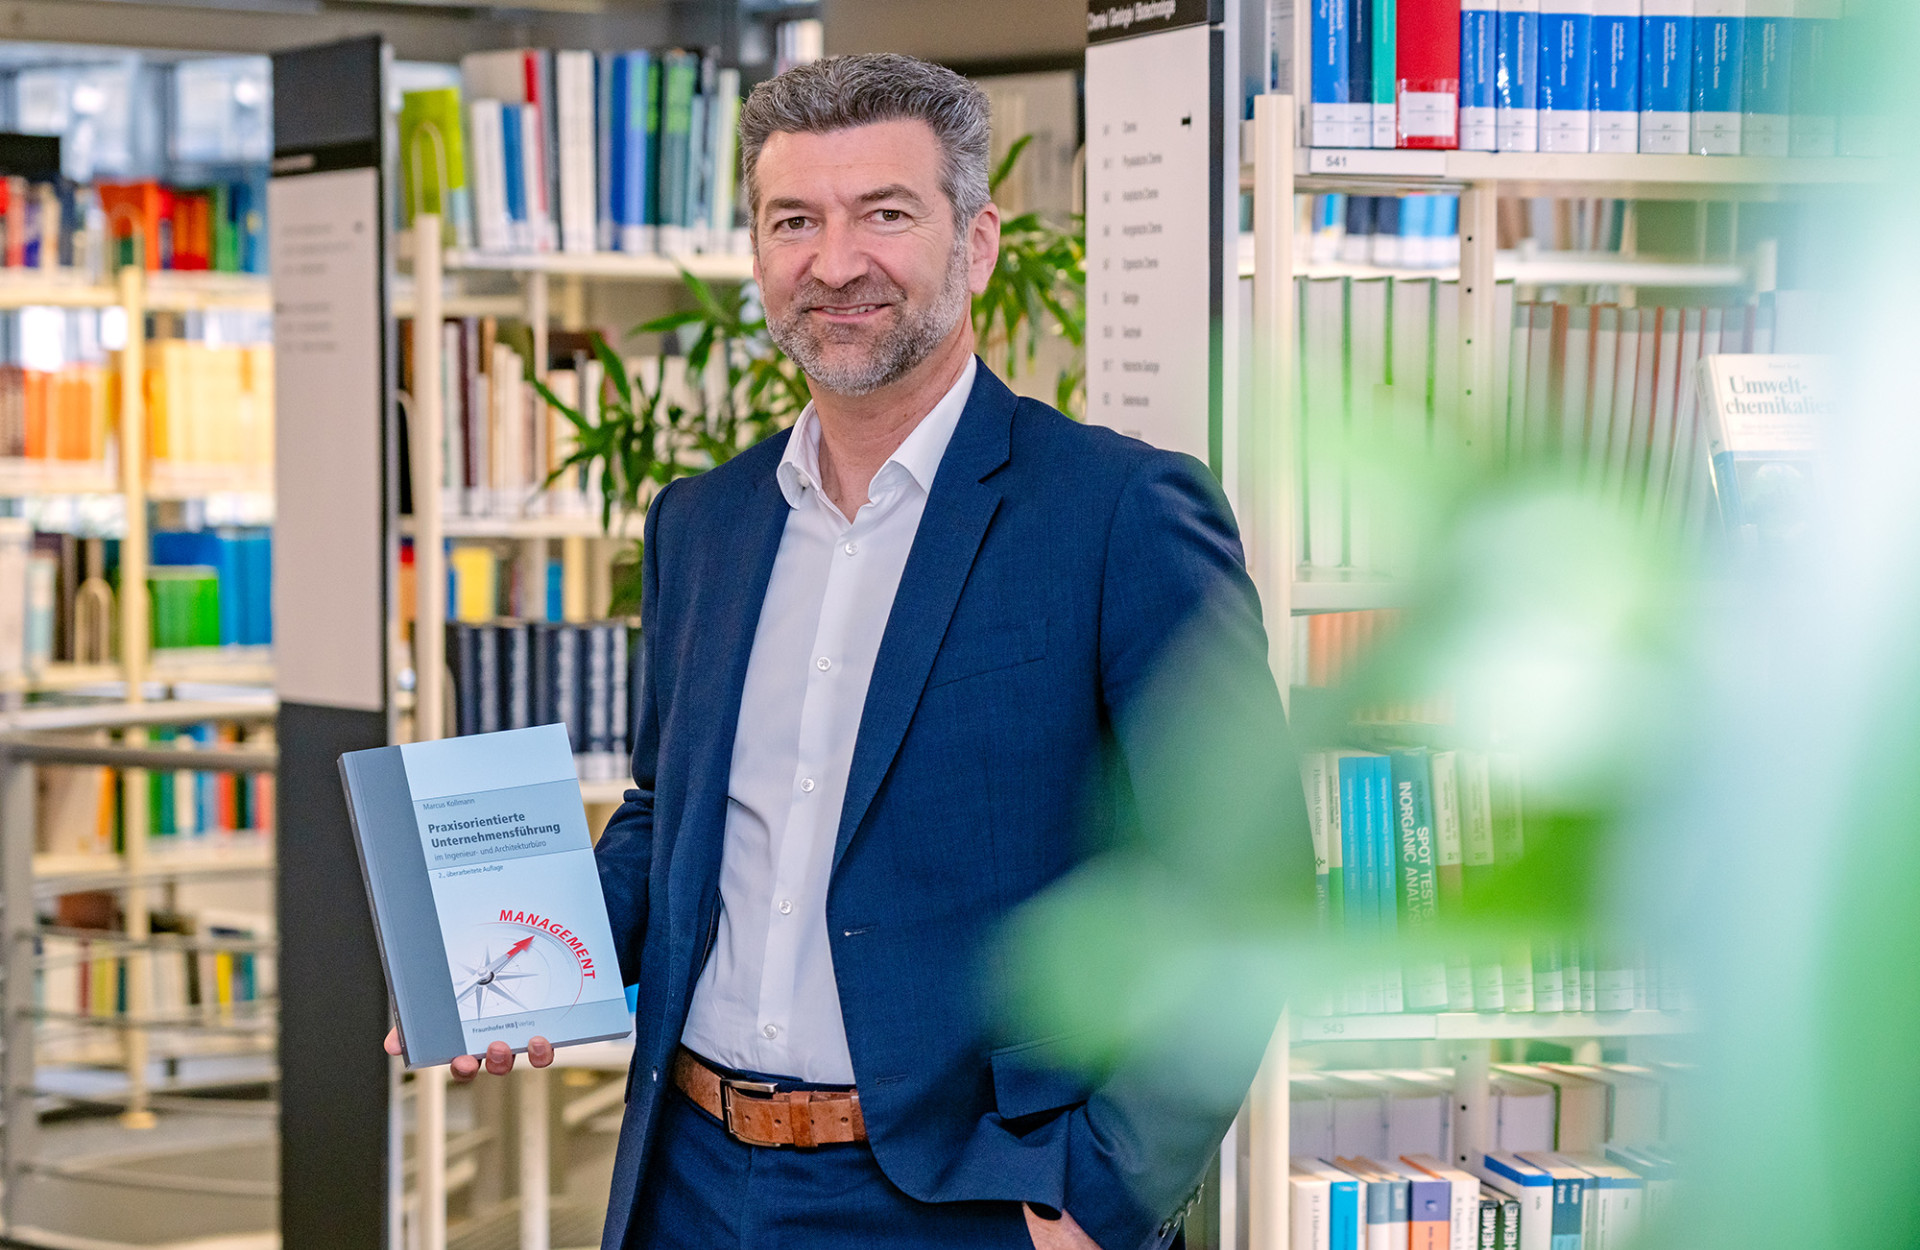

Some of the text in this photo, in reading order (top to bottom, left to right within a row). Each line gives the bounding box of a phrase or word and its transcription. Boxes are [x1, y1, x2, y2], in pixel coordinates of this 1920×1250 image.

[1326, 156, 1347, 167] 541
[1729, 375, 1808, 395] Umwelt-
[422, 798, 476, 810] Marcus Kollmann
[1312, 769, 1322, 836] Helmuth Galster
[428, 812, 526, 834] Praxisorientierte
[1399, 781, 1416, 862] INORGANIC
[431, 823, 561, 848] Unternehmensführung
[1416, 826, 1431, 866] SPOT
[434, 840, 547, 862] im Ingenieur- und Architekturbüro
[446, 866, 482, 877] überarbeitete
[483, 864, 504, 872] Auflage
[1420, 870, 1434, 919] TESTS
[500, 909, 596, 980] MANAGEMENT
[472, 1020, 535, 1034] Fraunhofer IRB Verlag
[1322, 1023, 1344, 1034] 543
